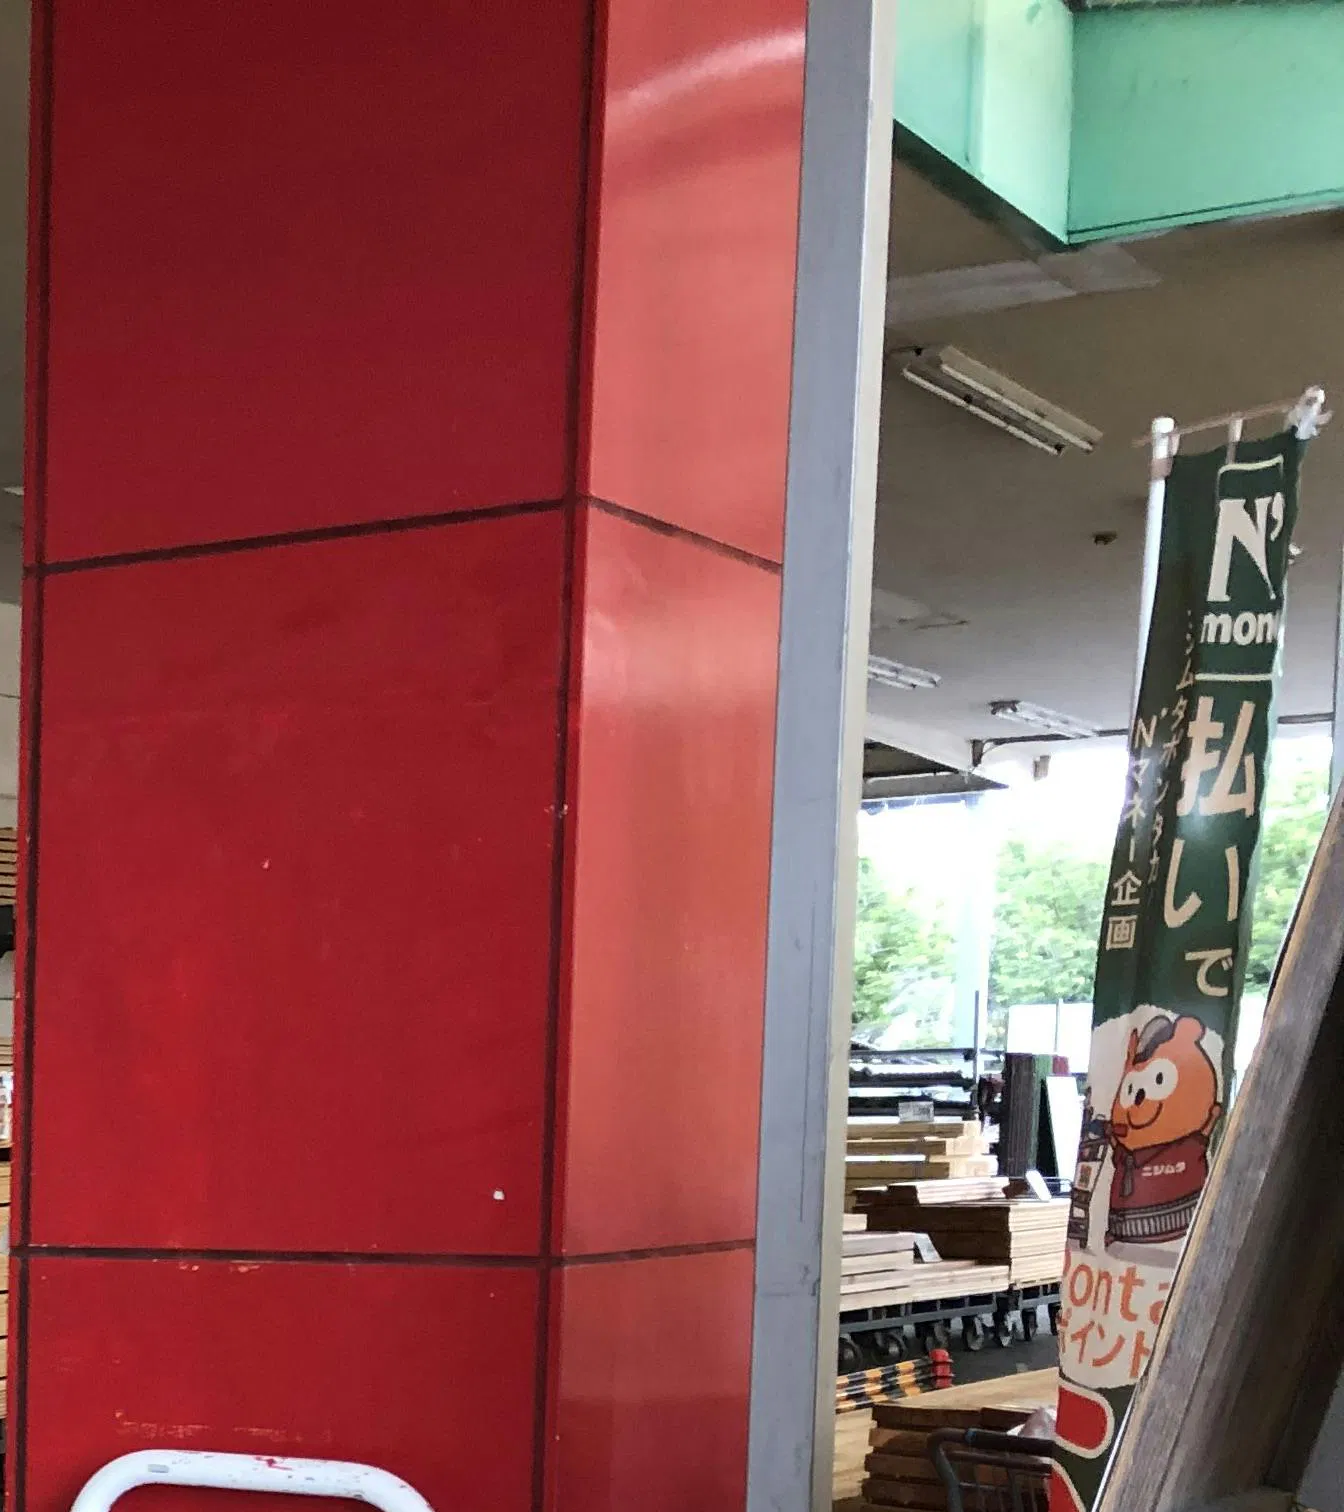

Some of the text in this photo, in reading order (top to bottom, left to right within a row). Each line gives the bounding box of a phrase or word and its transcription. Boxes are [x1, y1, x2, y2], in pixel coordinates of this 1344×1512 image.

[1200, 611, 1279, 645] mon
[1164, 696, 1257, 997] 払いで
